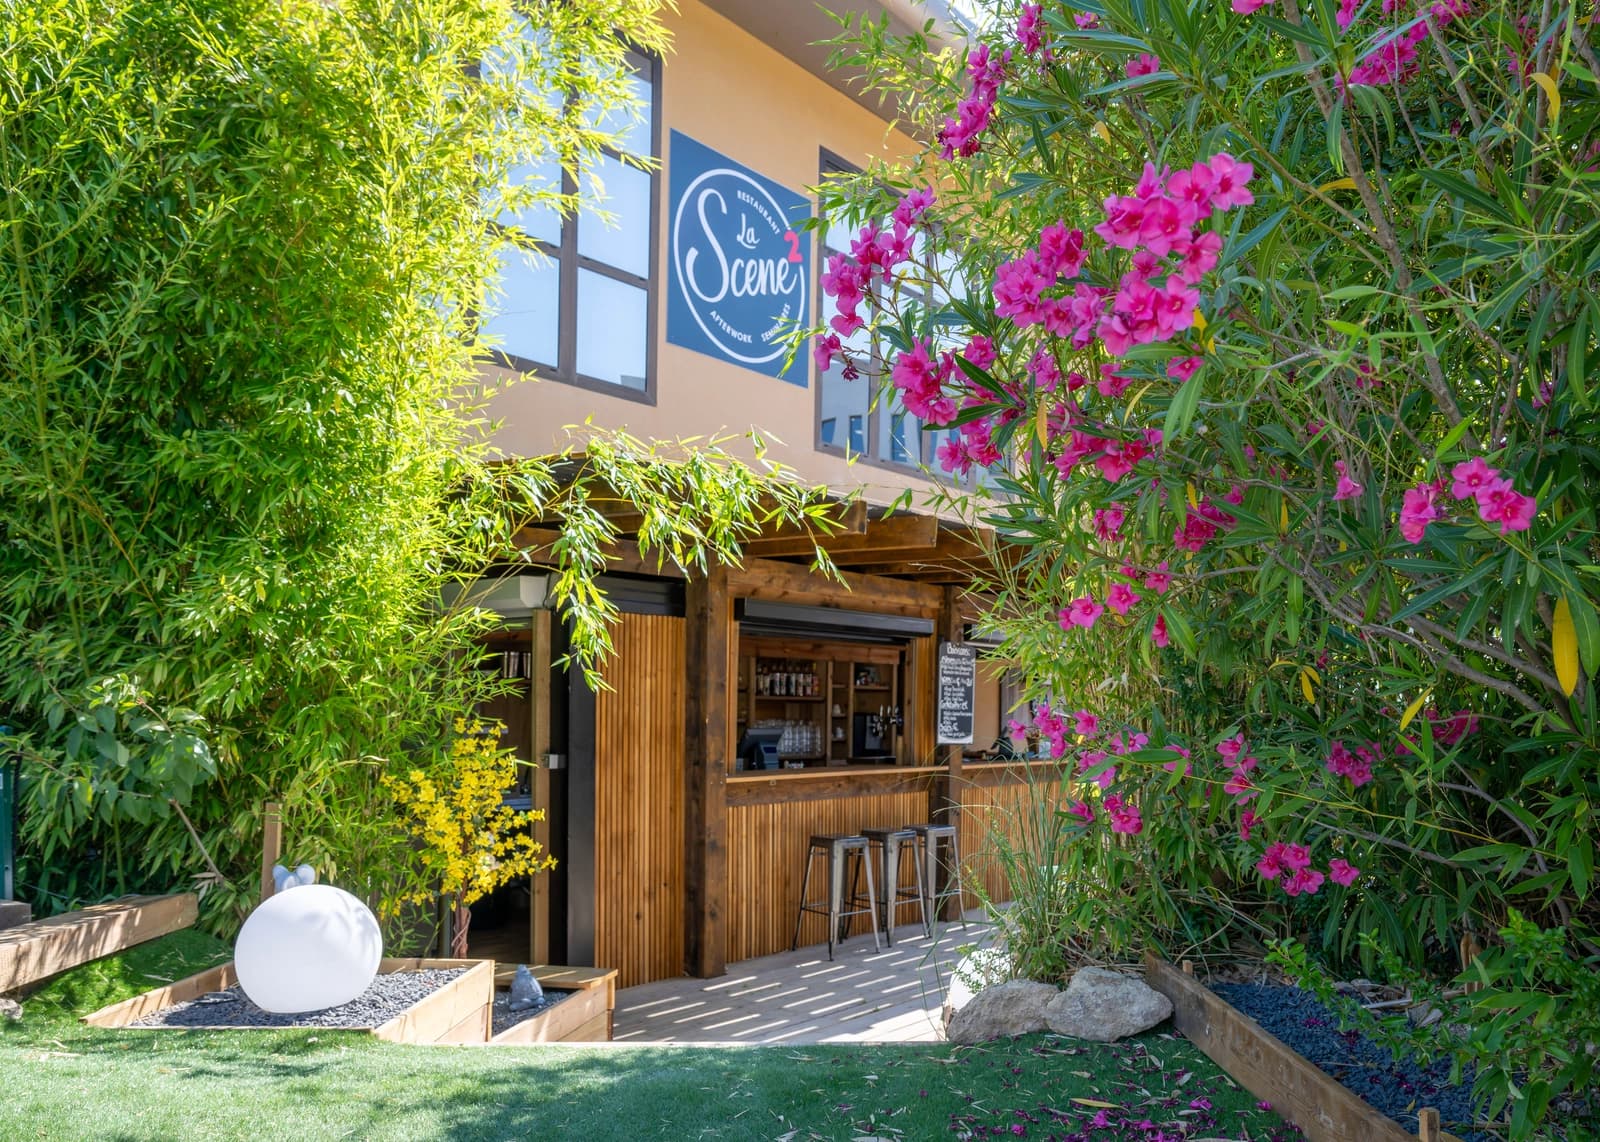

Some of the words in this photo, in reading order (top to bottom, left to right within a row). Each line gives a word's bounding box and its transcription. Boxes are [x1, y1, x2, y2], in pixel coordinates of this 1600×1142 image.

[736, 213, 760, 249] La
[737, 190, 780, 235] RESTAURANT
[710, 310, 752, 344] AFTERWORK
[760, 303, 791, 342] SEMINARES
